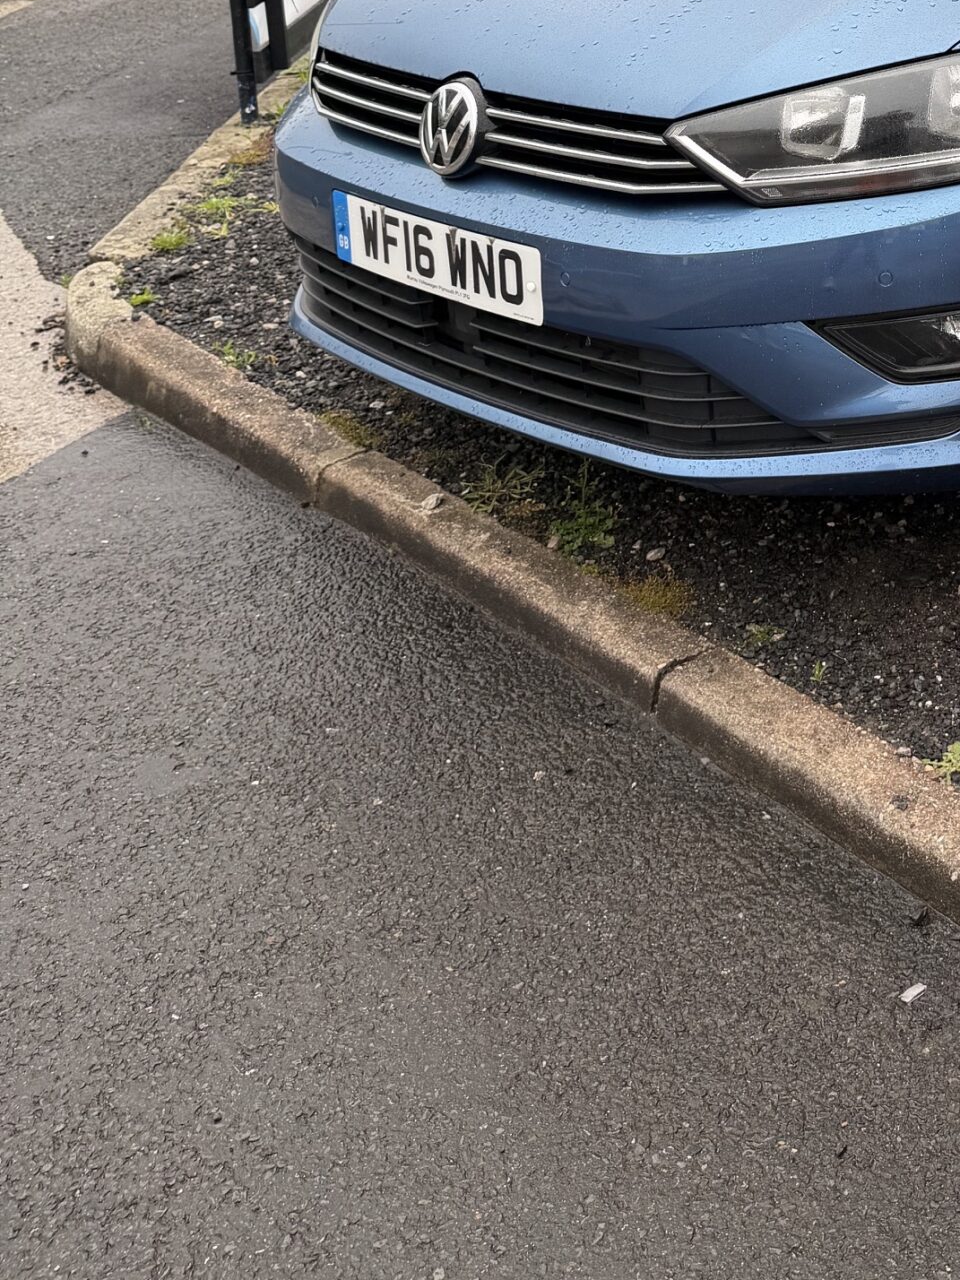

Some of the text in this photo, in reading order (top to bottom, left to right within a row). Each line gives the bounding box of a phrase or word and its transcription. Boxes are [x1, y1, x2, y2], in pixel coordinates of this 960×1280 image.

[338, 233, 349, 250] GB
[360, 206, 524, 306] WF16 WNO
